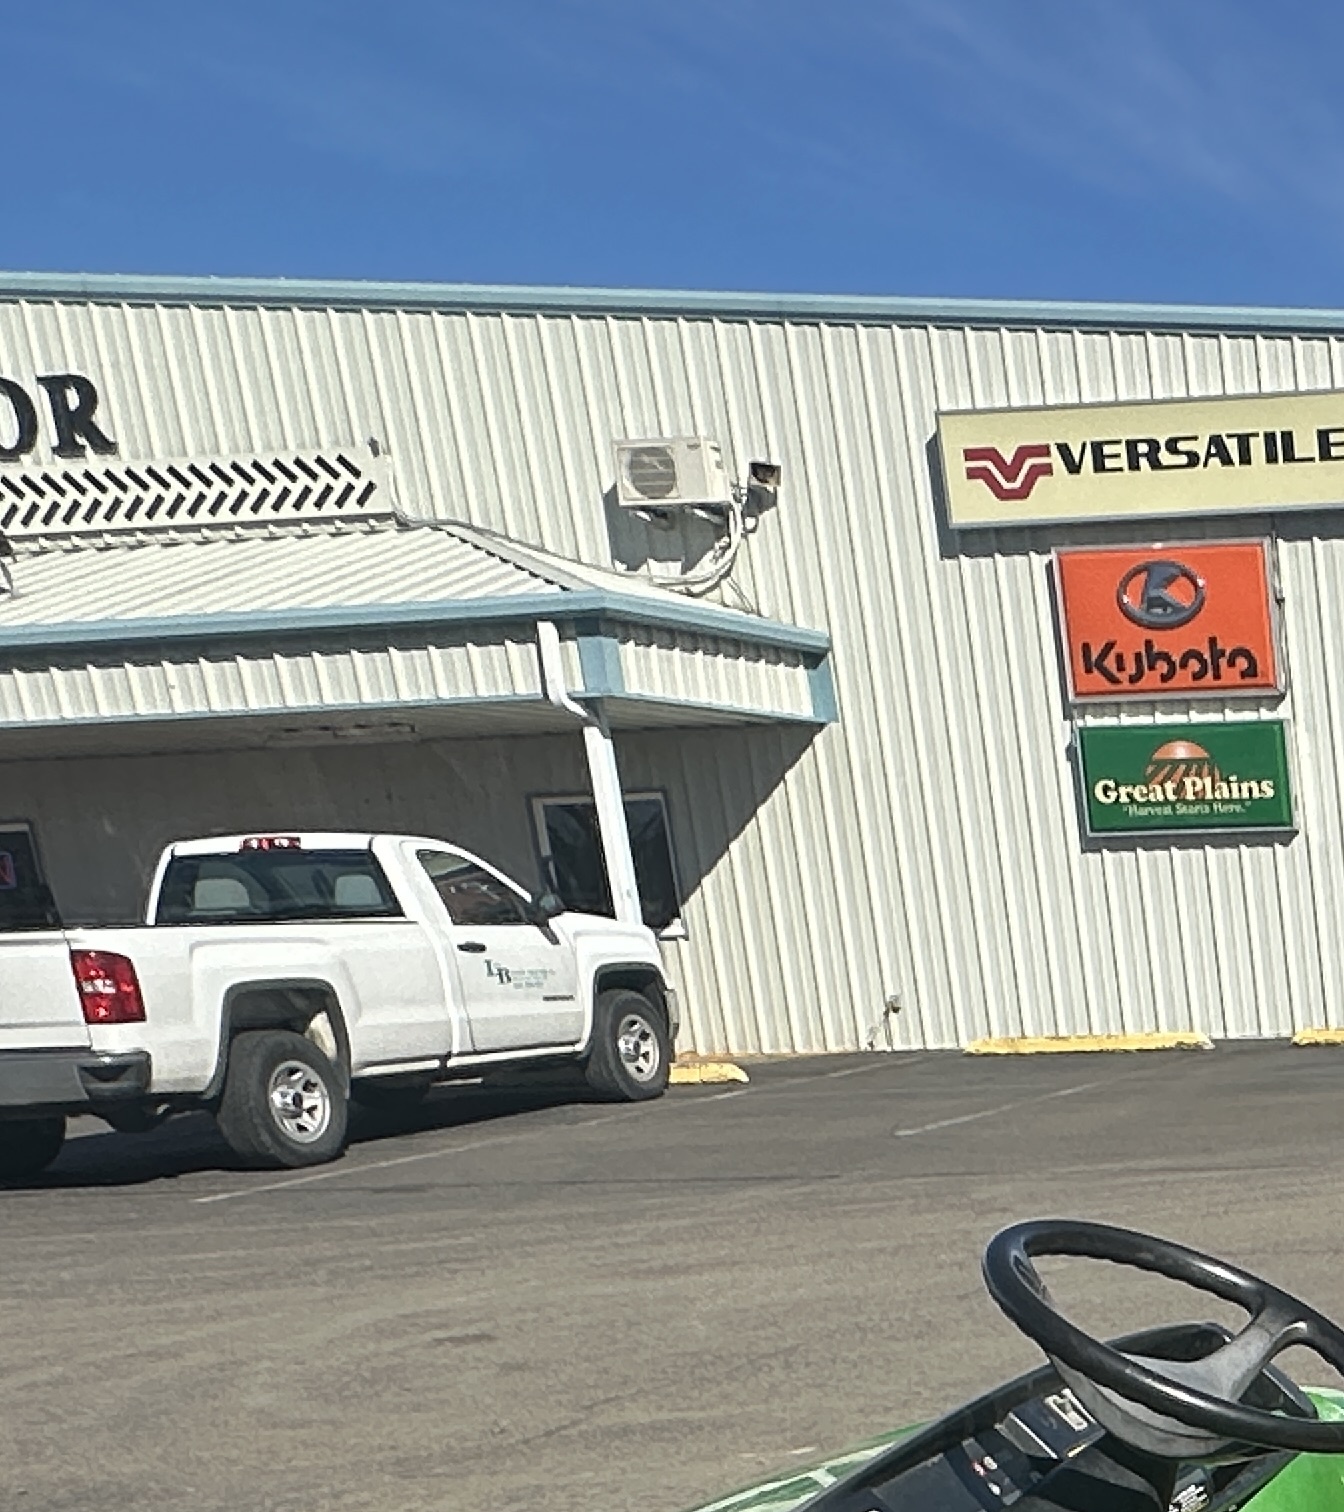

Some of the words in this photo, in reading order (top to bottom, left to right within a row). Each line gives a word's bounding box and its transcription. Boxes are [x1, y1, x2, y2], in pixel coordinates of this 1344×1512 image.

[1081, 636, 1259, 685] Kubota
[1094, 778, 1178, 804] Great
[1183, 775, 1275, 801] Plains
